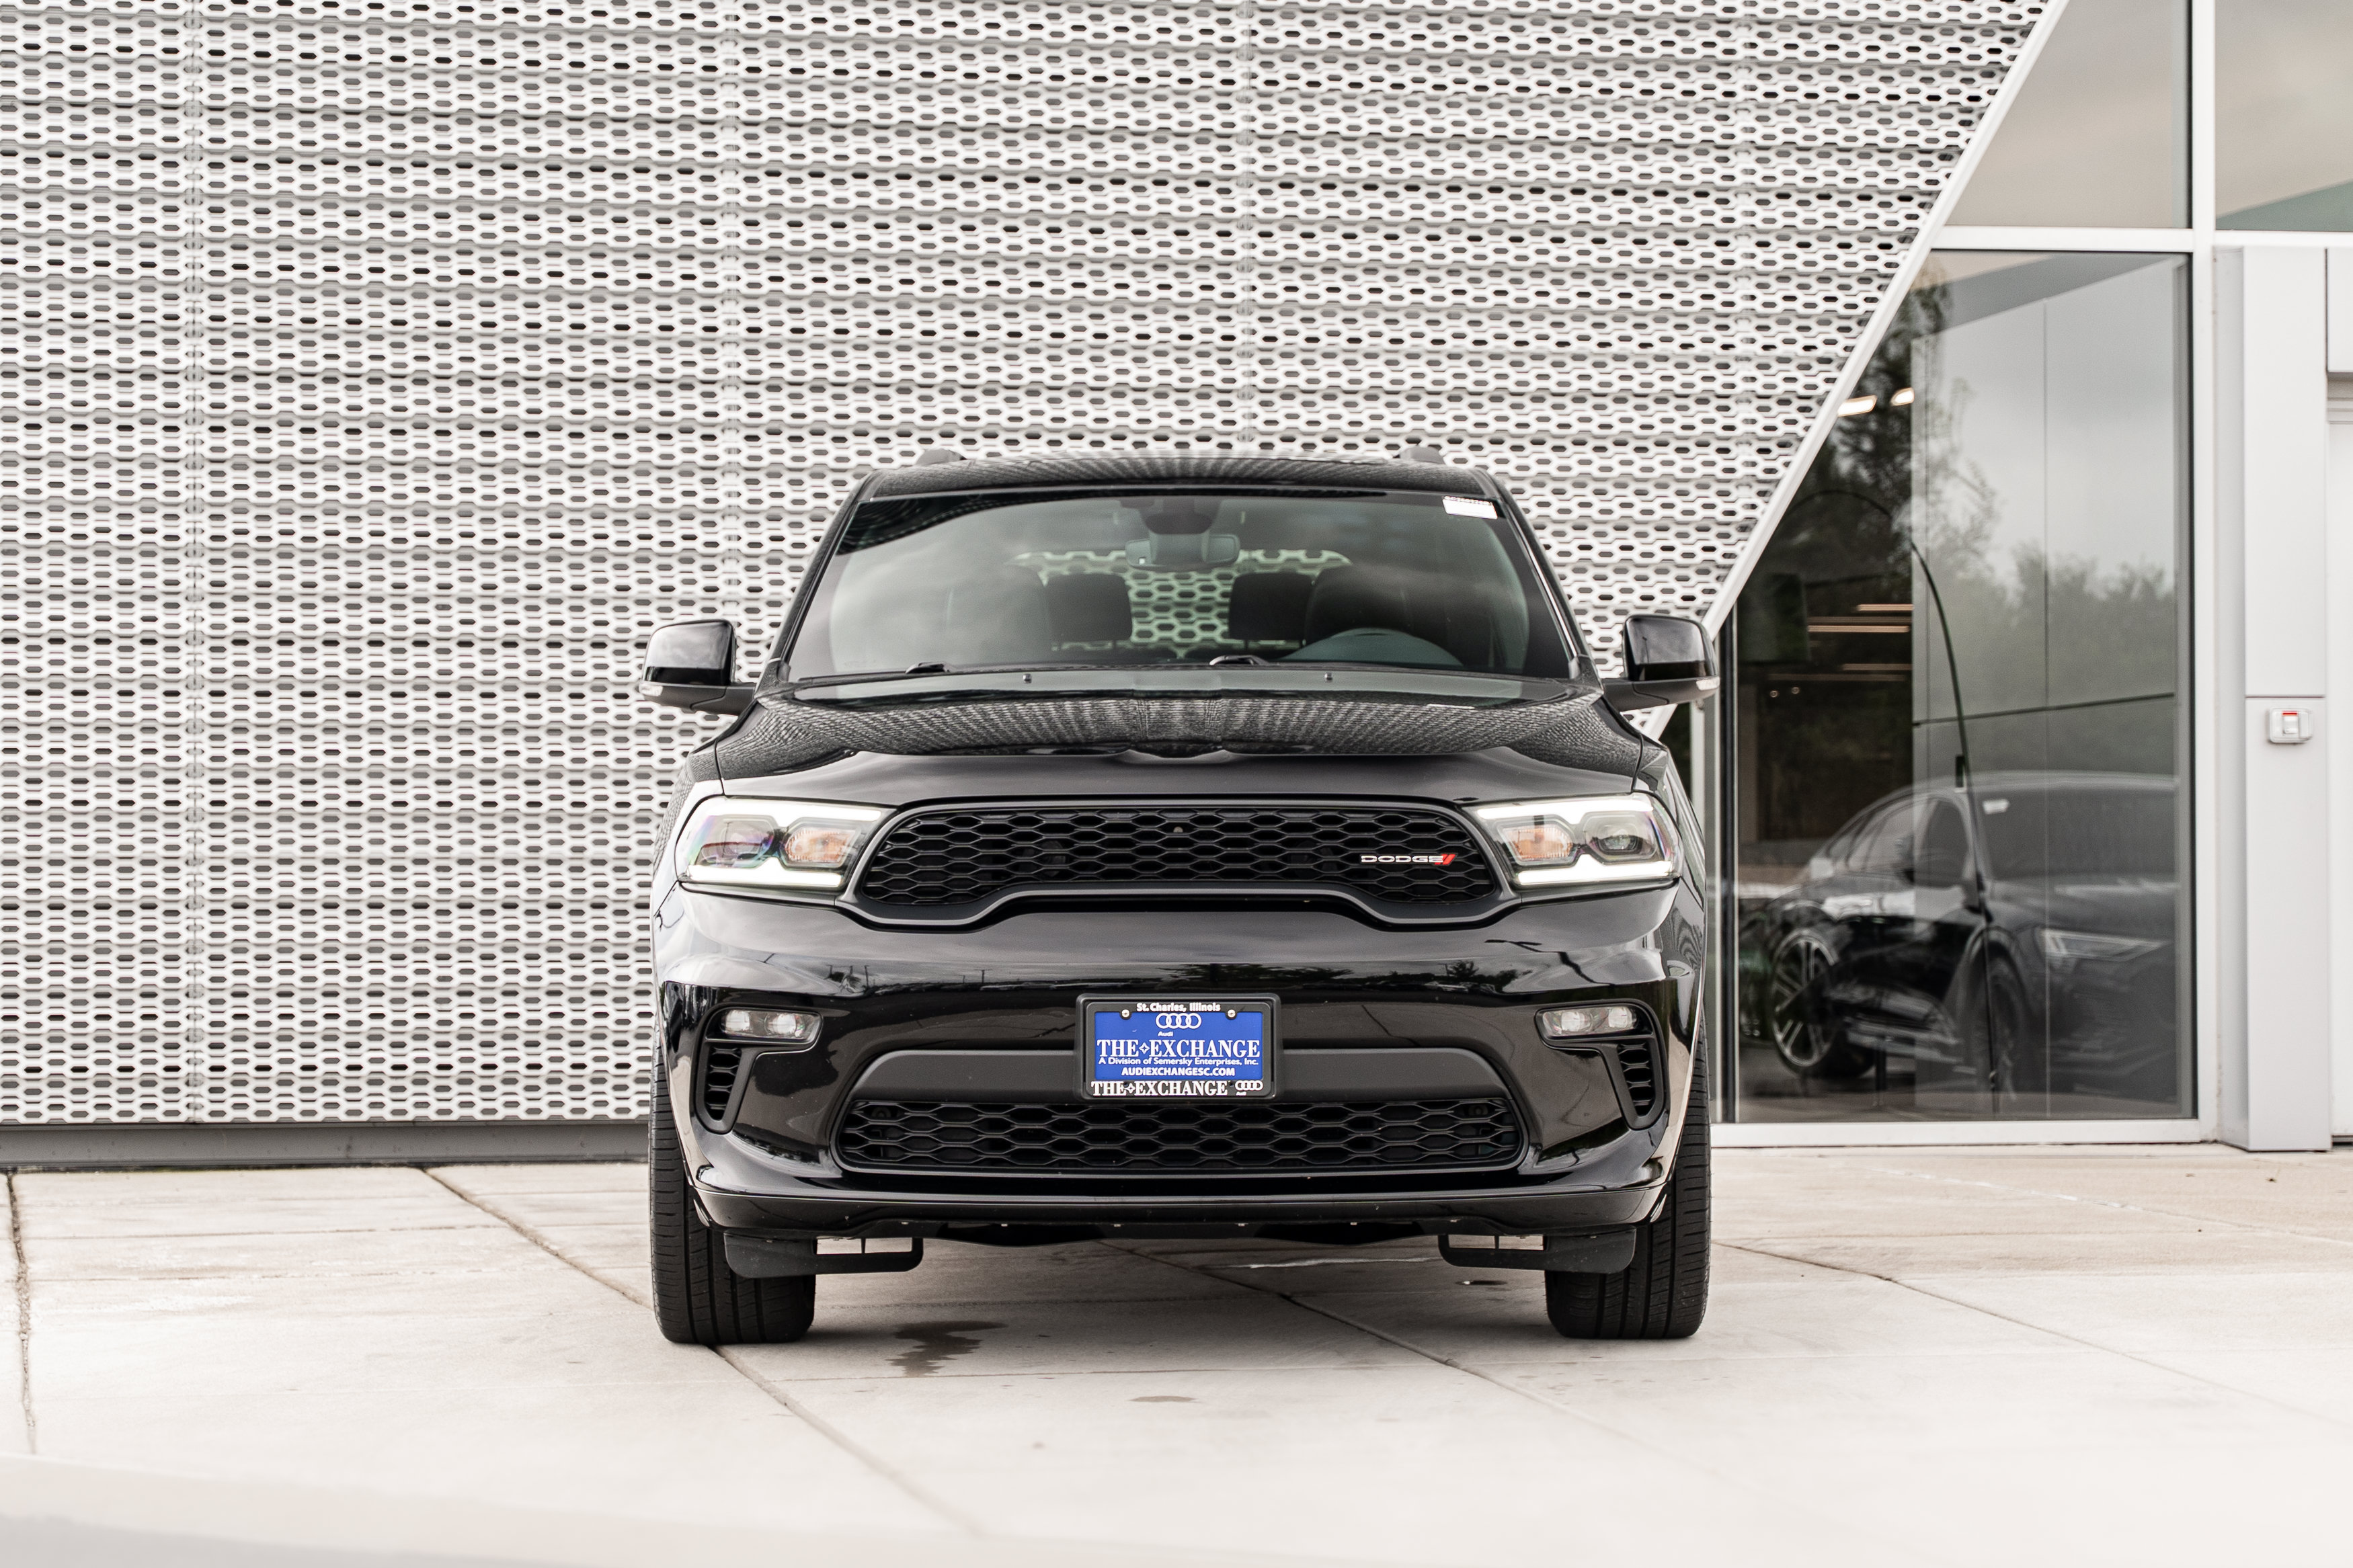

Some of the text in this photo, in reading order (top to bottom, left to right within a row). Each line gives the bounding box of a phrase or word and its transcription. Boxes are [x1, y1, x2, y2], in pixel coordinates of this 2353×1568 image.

[1361, 855, 1444, 863] DODGE
[1136, 1003, 1221, 1012] St. Charles, Illinois
[1097, 1040, 1260, 1057] THE EXCHANGE
[1154, 1057, 1193, 1066] Semersky
[1195, 1057, 1242, 1066] Enterprises,
[1121, 1067, 1235, 1076] AUDIEXCHANGESC.COM
[1091, 1081, 1228, 1096] THE EXCHANGE
